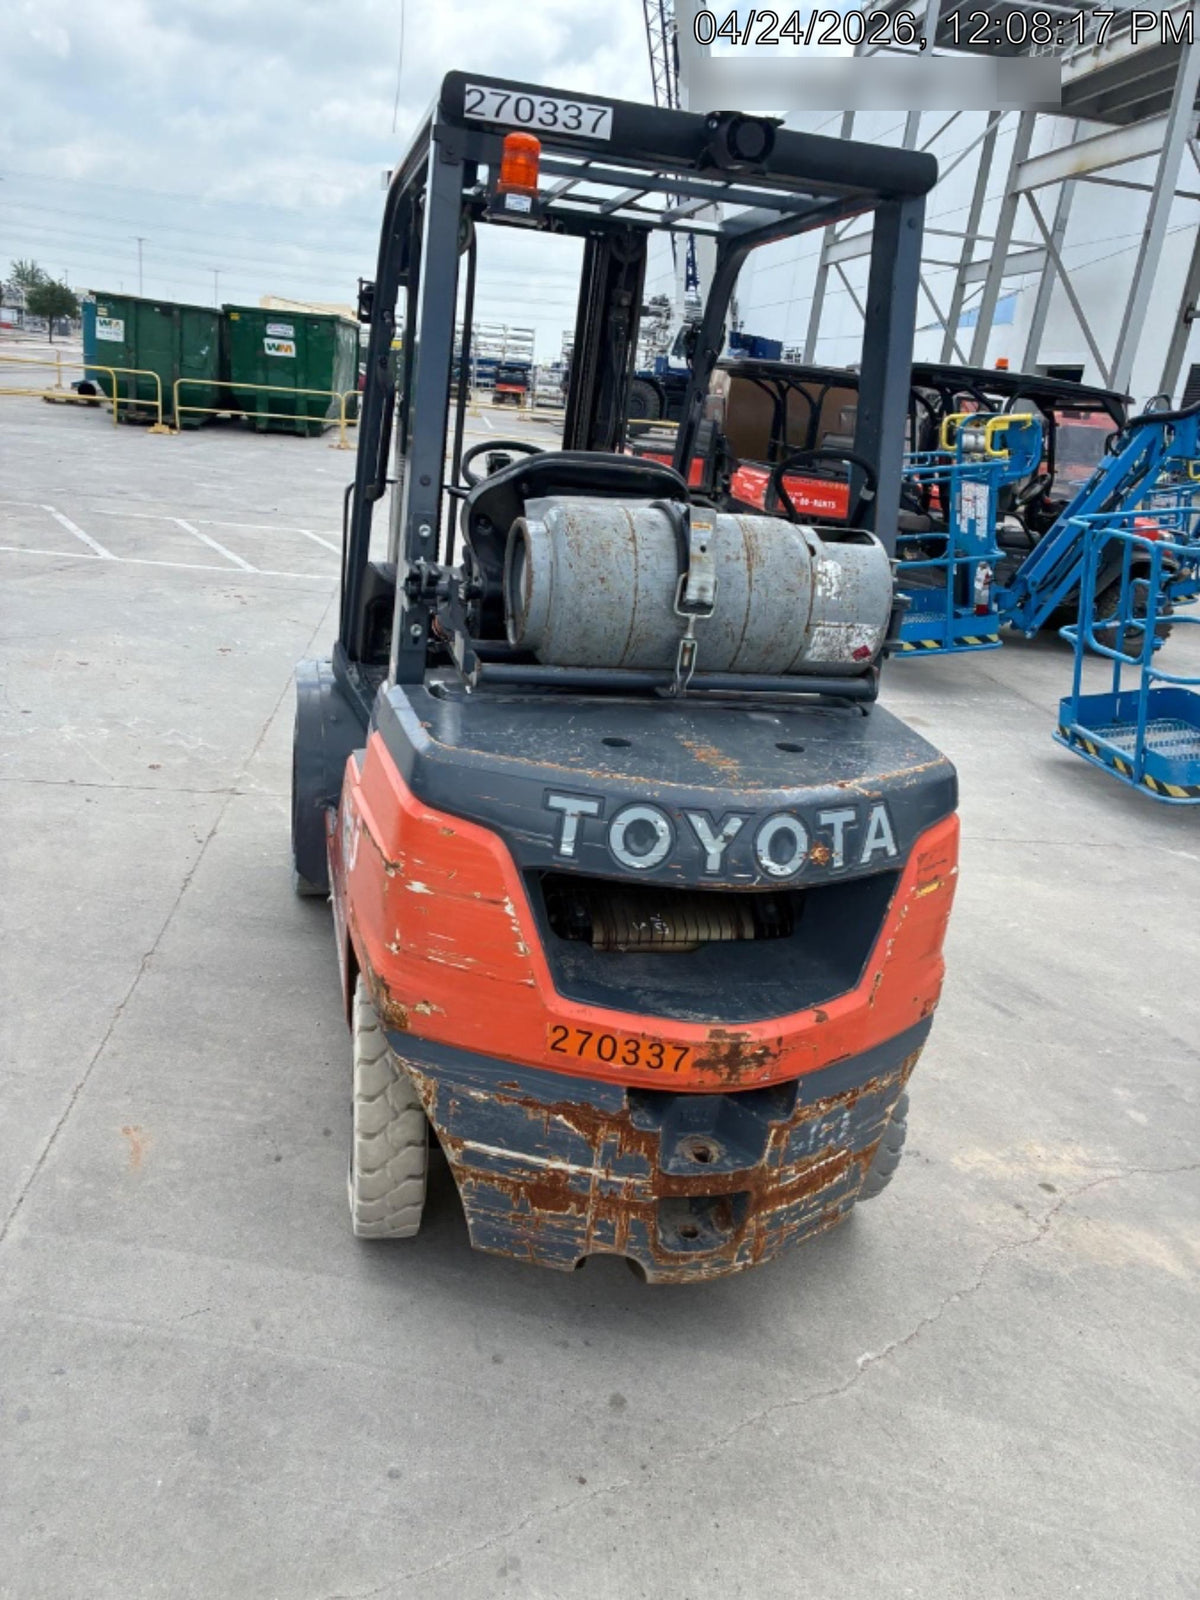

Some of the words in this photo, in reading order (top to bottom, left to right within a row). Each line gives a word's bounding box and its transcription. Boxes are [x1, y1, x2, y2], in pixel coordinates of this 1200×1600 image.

[464, 88, 608, 134] 270337
[266, 342, 293, 354] WM
[546, 794, 899, 878] TOYOTA
[550, 1024, 691, 1073] 270337
